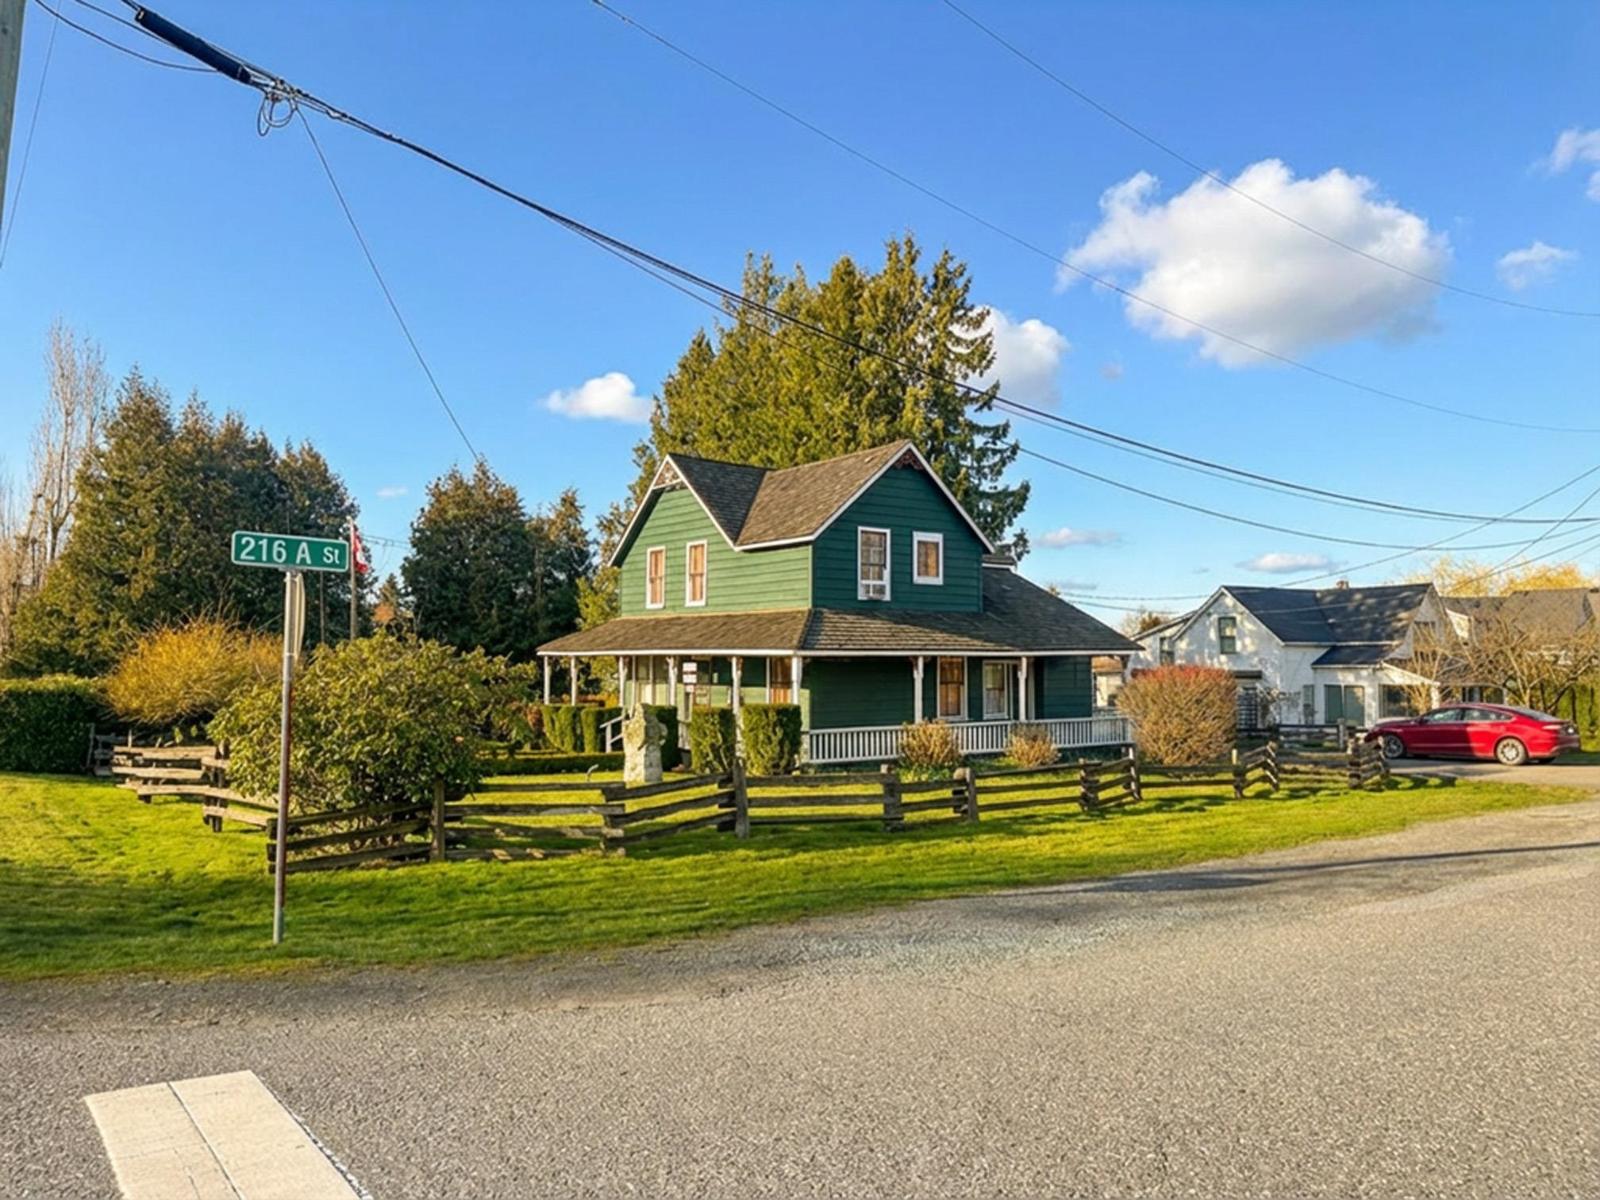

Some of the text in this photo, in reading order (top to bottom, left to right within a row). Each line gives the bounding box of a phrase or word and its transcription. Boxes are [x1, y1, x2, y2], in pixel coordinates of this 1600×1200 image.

[240, 537, 340, 564] 216 A St
